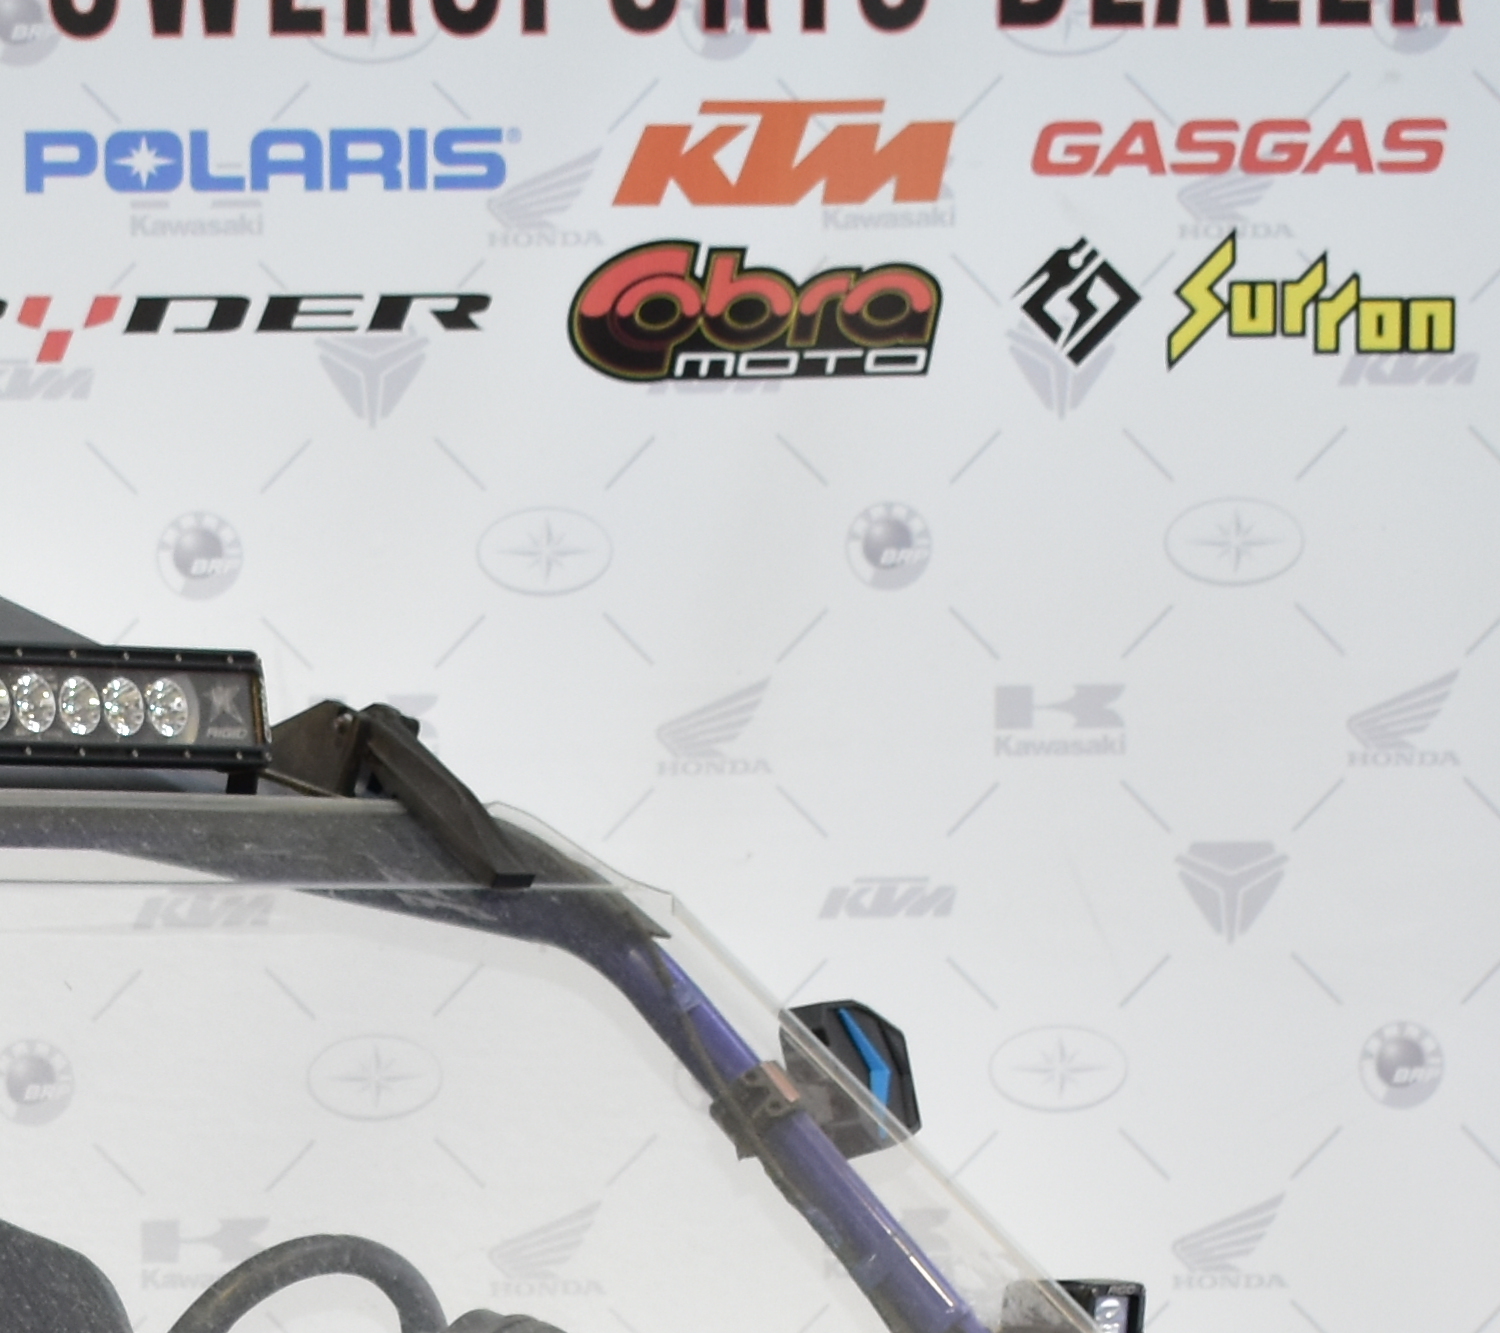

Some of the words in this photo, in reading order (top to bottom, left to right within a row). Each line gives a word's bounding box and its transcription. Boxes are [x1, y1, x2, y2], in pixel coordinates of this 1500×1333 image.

[612, 97, 956, 208] KTM
[1032, 118, 1447, 176] GASGAS
[23, 127, 508, 195] POLARIS
[129, 214, 265, 236] Kawasaki
[822, 206, 955, 229] Kawasaki
[489, 230, 604, 248] HONDA
[1178, 222, 1293, 240] HONDA
[568, 238, 943, 380] Cobra
[1339, 352, 1478, 388] KTM
[994, 735, 1126, 756] Kawasaki
[657, 757, 773, 776] HONDA
[1346, 749, 1461, 766] HONDA
[133, 886, 277, 930] KTM
[819, 875, 957, 919] KTM
[490, 1279, 605, 1297] HONDA
[1173, 1272, 1288, 1290] HONDA
